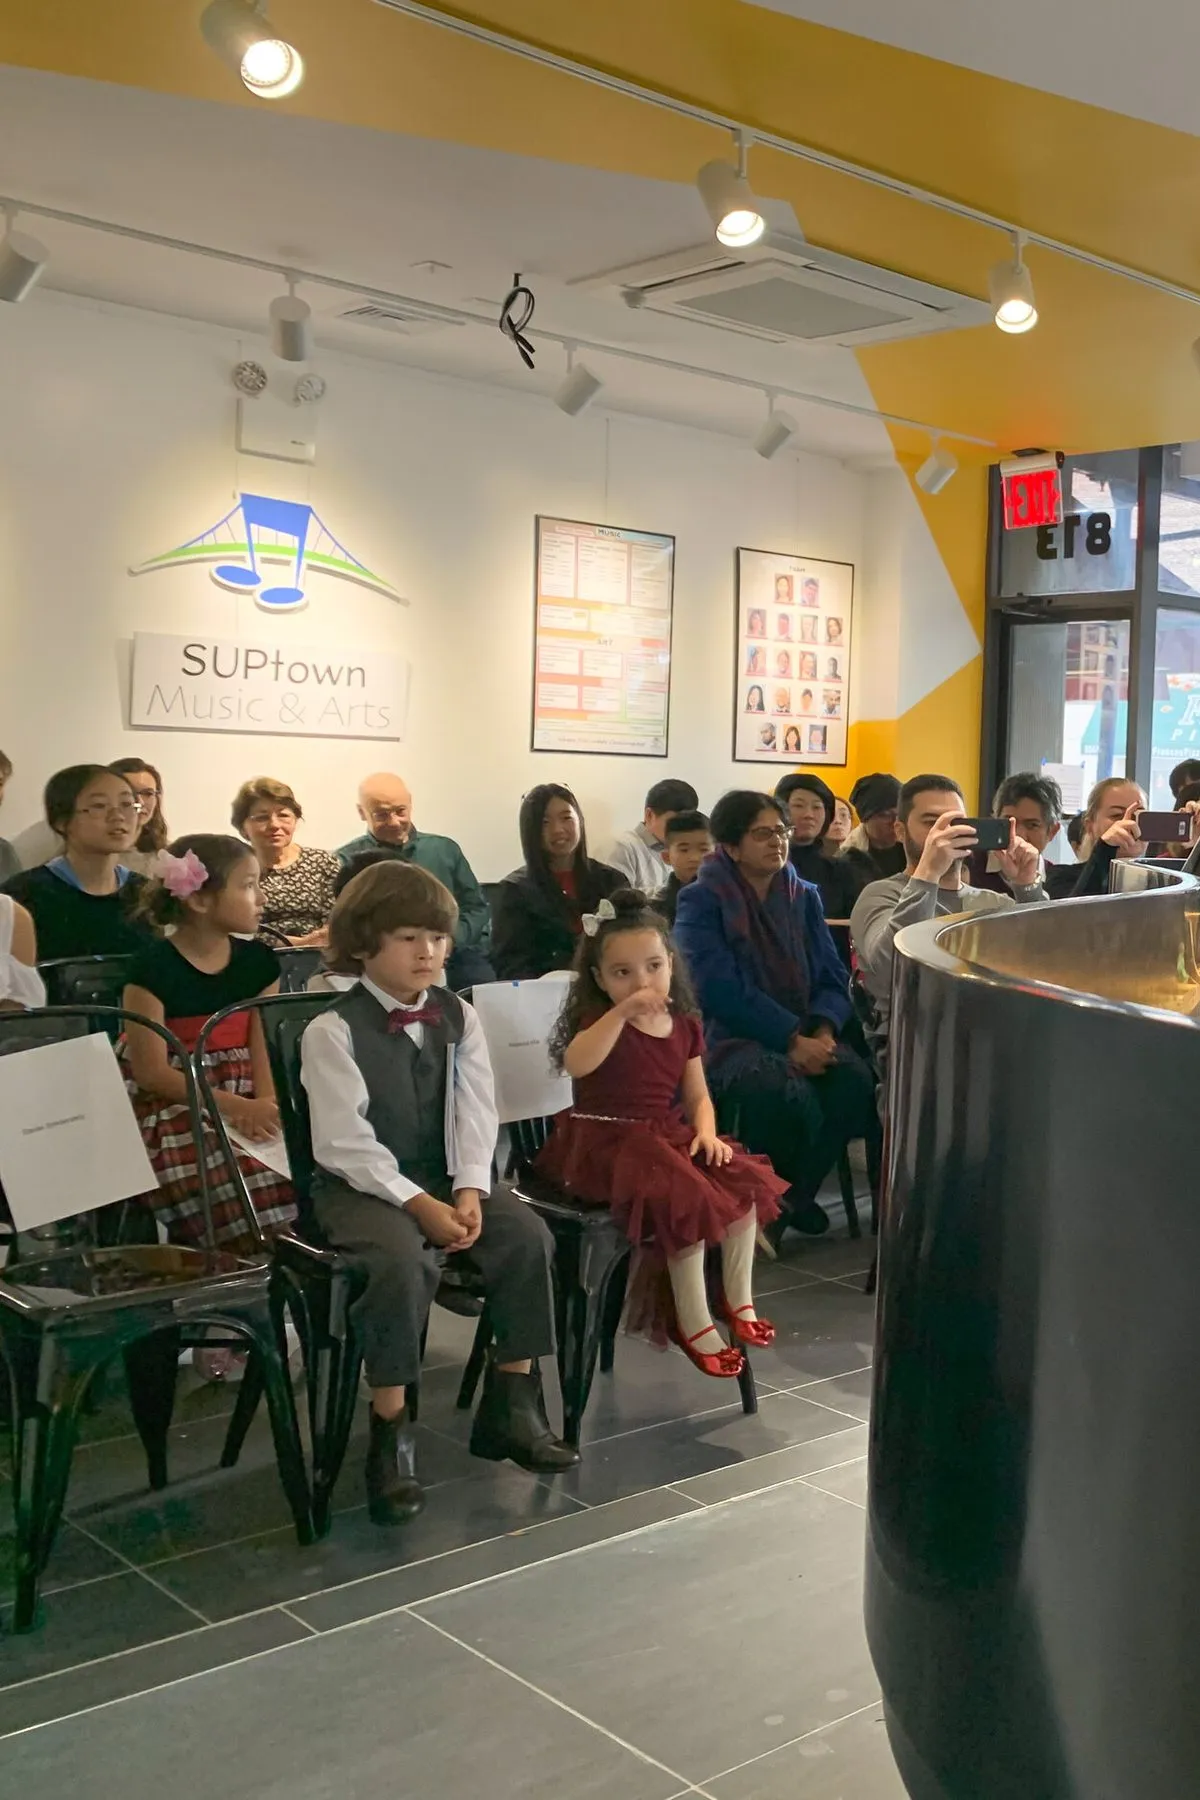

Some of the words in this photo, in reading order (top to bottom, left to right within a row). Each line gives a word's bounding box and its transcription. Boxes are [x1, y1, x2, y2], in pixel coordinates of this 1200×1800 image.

[181, 642, 366, 688] SUPtown
[146, 684, 264, 722] Music
[278, 691, 307, 726] &
[318, 694, 392, 730] Arts
